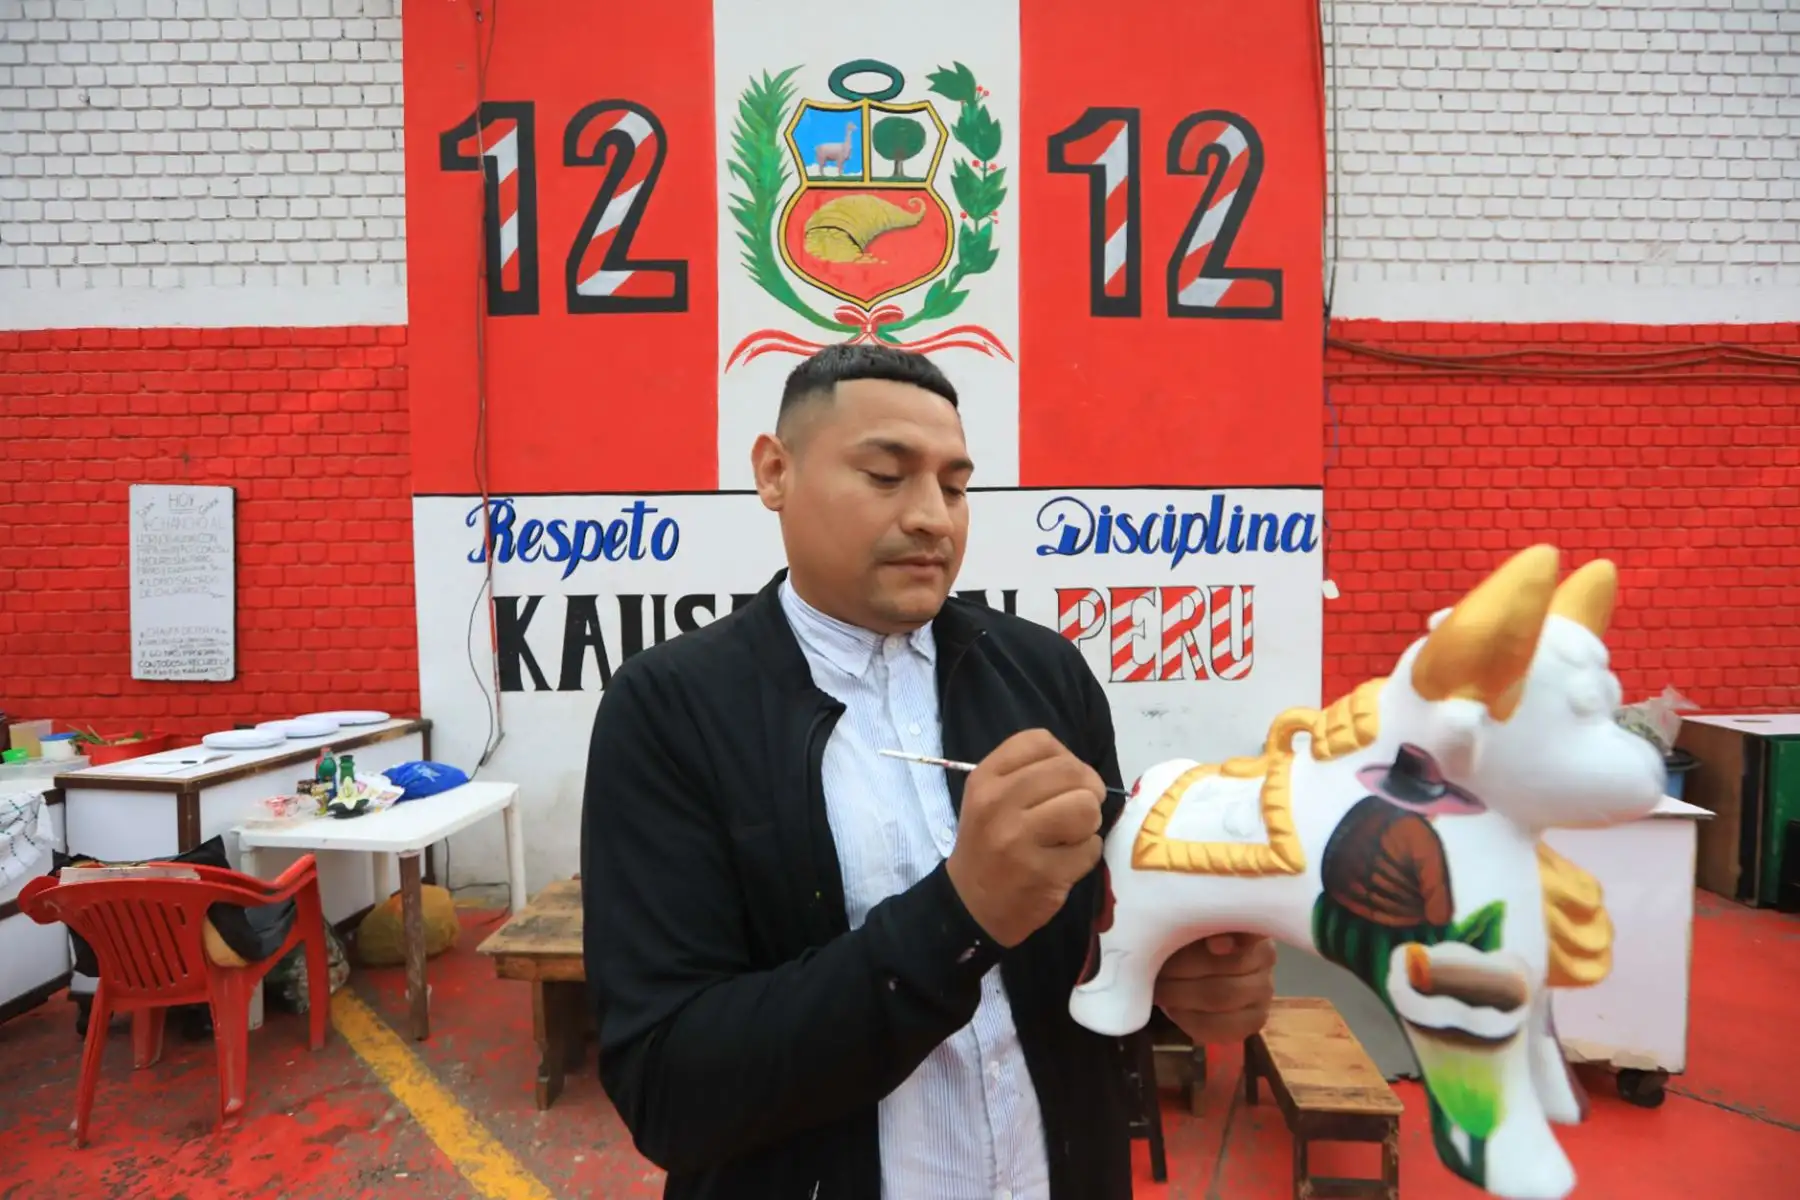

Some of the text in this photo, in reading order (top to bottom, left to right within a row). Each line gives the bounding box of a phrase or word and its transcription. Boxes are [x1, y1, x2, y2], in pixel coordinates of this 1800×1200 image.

[439, 99, 689, 316] 12
[1047, 106, 1283, 320] 12
[466, 497, 680, 580] Respeto
[1036, 493, 1318, 571] Disciplina
[1055, 584, 1255, 683] PERU
